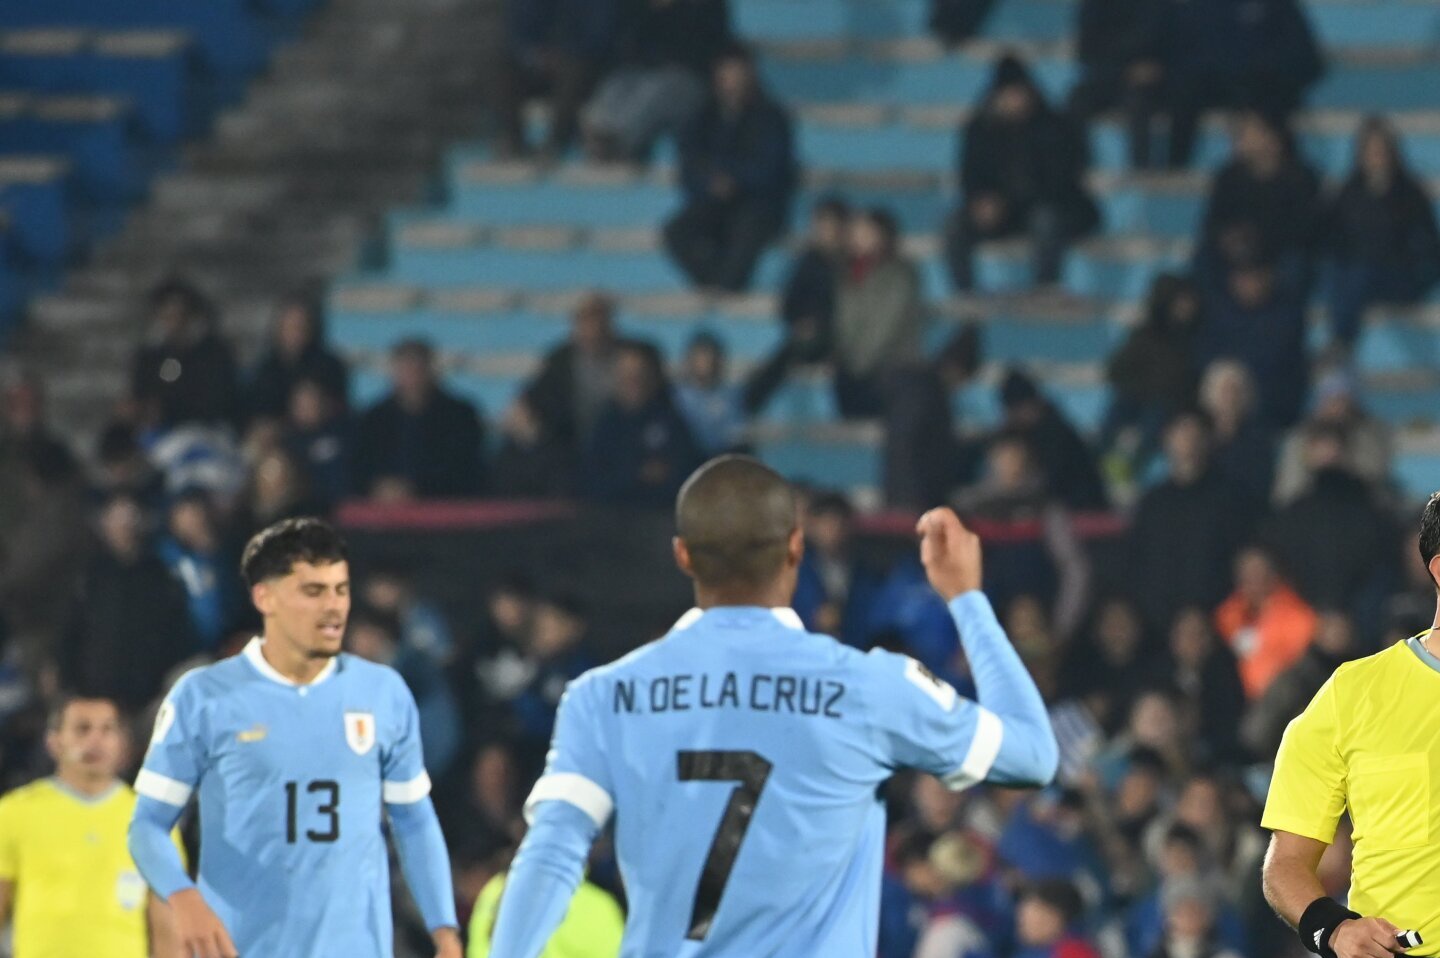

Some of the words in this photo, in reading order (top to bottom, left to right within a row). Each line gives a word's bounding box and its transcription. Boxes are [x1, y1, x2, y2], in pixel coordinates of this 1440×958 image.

[613, 679, 643, 714] N.
[650, 674, 693, 713] DE
[700, 671, 739, 709] LA
[749, 674, 846, 719] CRUZ
[285, 779, 339, 844] 13
[676, 750, 774, 941] 7
